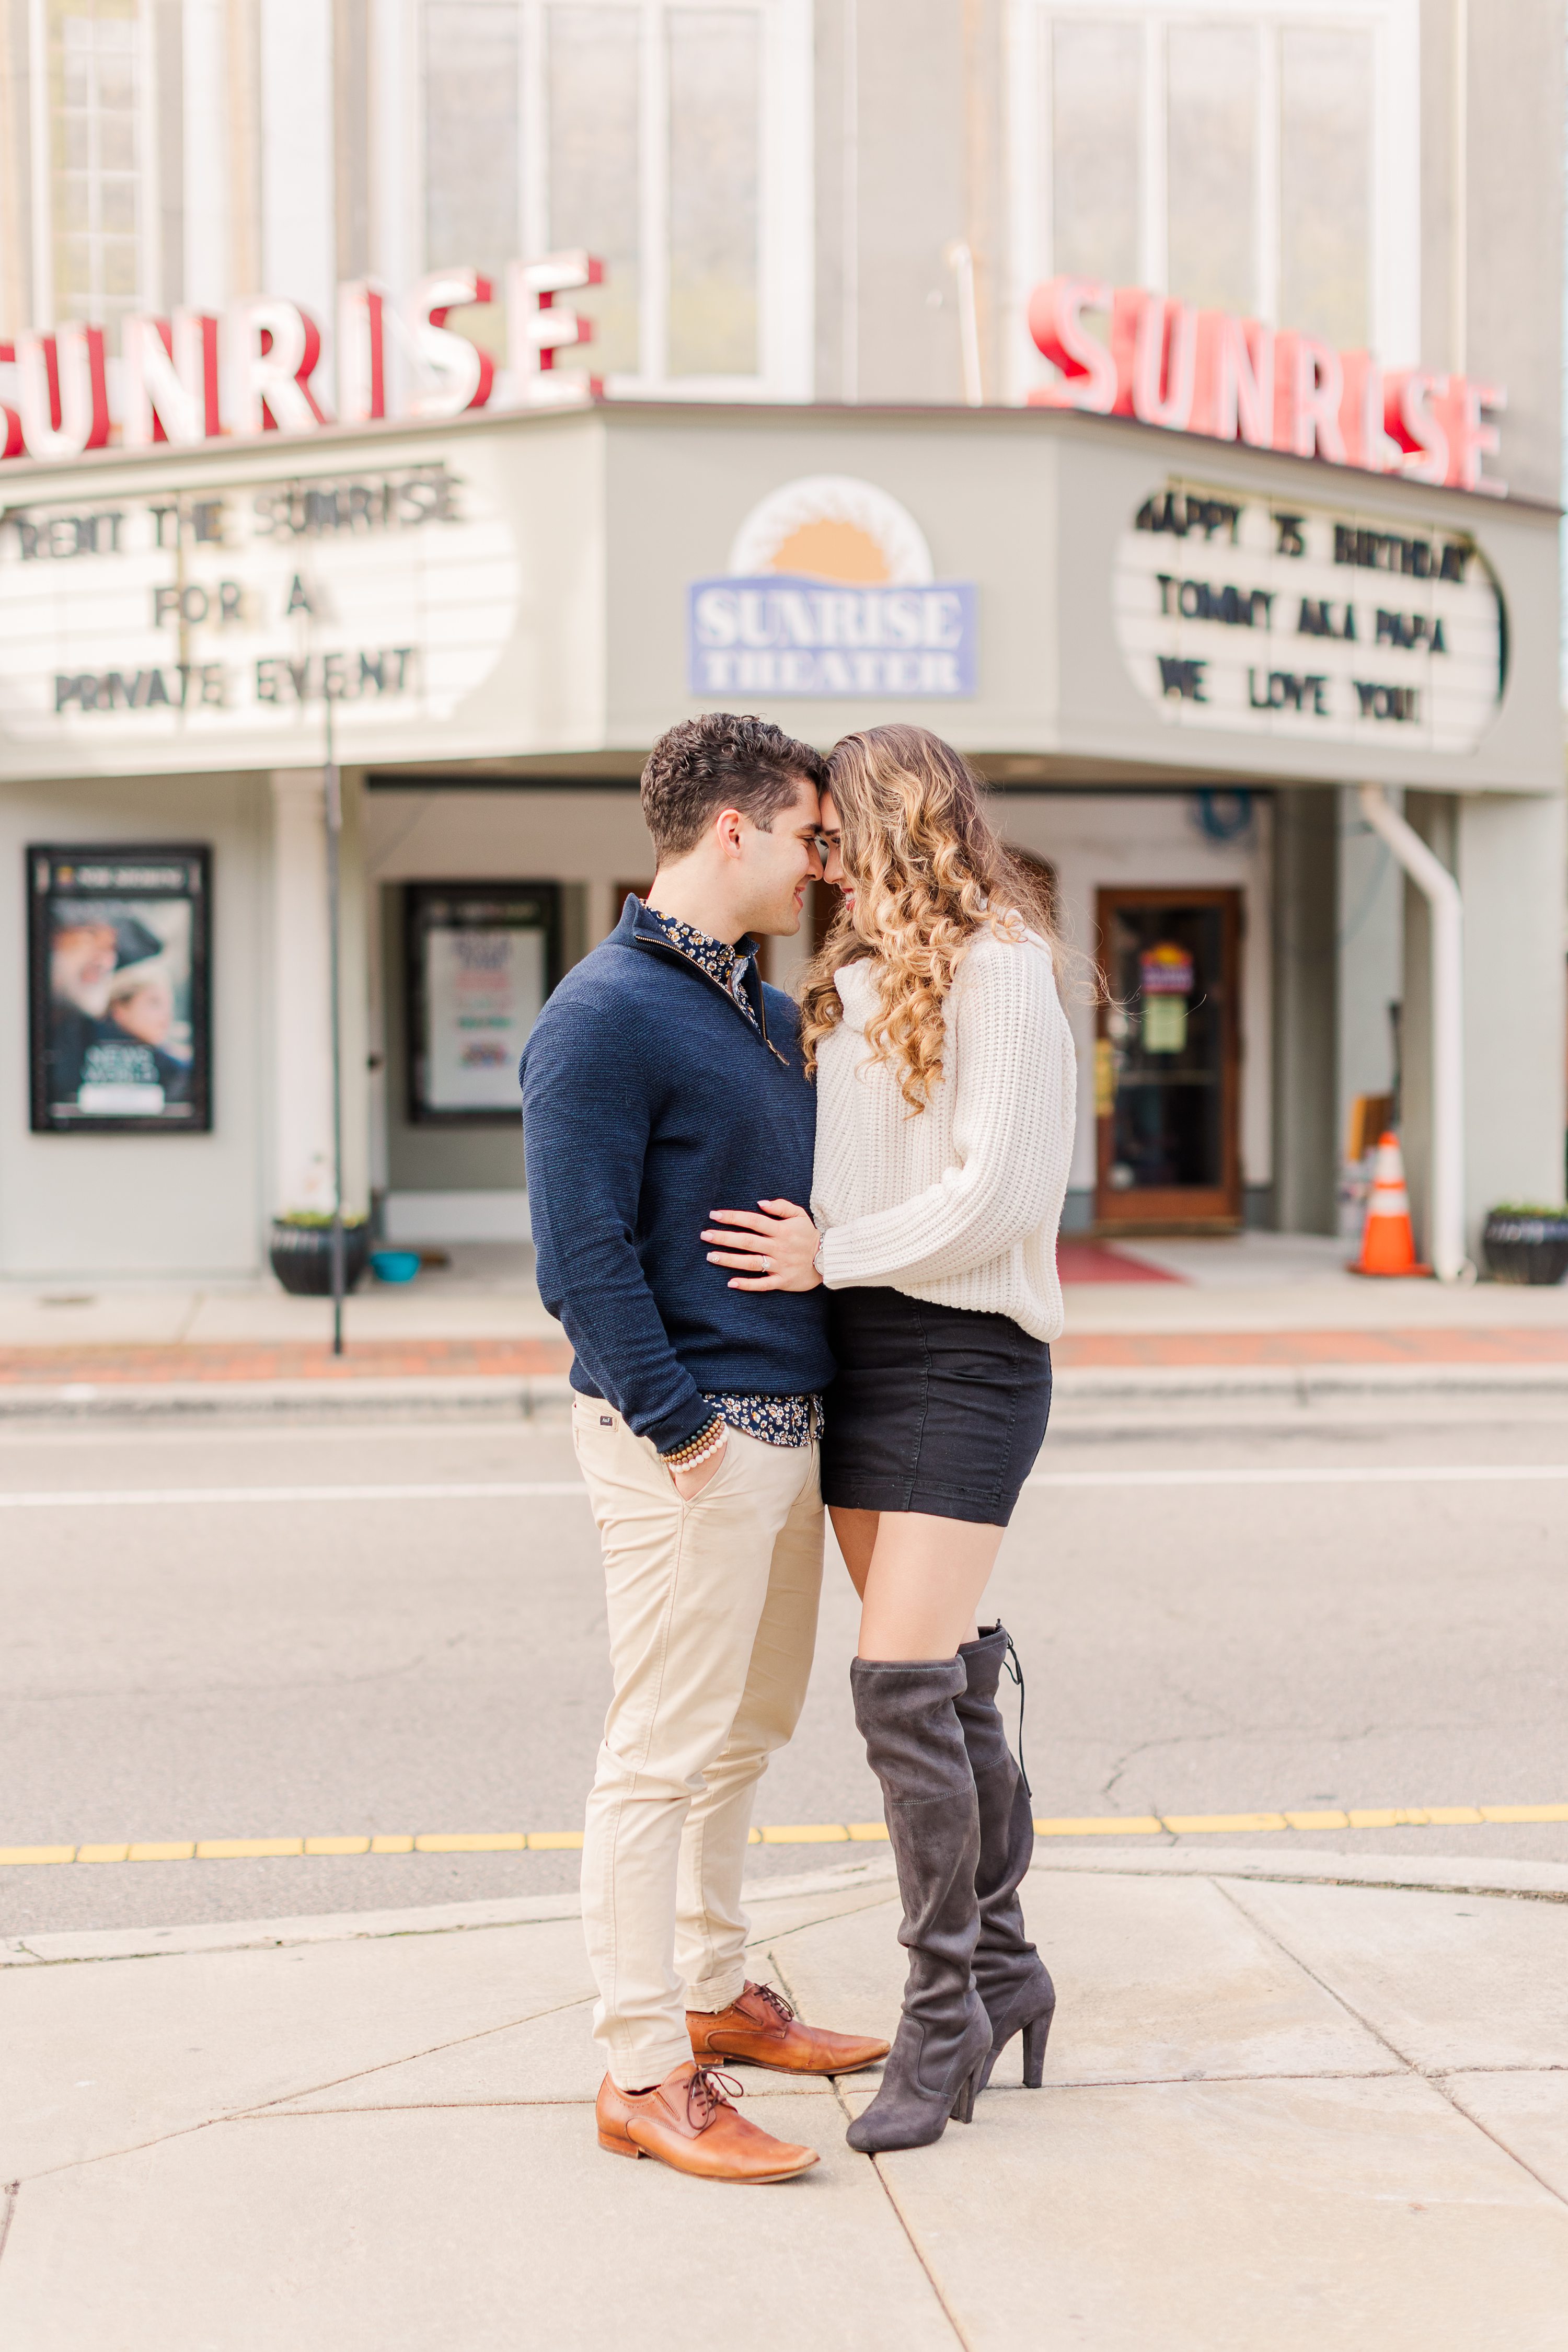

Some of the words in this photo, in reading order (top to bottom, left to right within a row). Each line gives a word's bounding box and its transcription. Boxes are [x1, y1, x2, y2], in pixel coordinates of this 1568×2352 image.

[0, 249, 604, 463] UNRISE
[1028, 274, 1508, 497] SUNRISE
[19, 512, 123, 559] RENT
[149, 500, 223, 548] THE
[253, 477, 465, 535] SUNRISE
[1334, 524, 1475, 584] BIRTHDAY
[154, 581, 241, 627] FOR
[286, 573, 314, 615] A
[695, 588, 963, 649] SUNRISE
[1156, 573, 1274, 630] TOMMY
[1299, 597, 1356, 640] AKA
[1376, 607, 1447, 653] PAPA
[54, 663, 223, 712] PRIVATE
[256, 647, 413, 703] EVENT
[699, 651, 962, 692] THEATER
[1157, 655, 1207, 702] WE
[1249, 667, 1328, 715] LOVE
